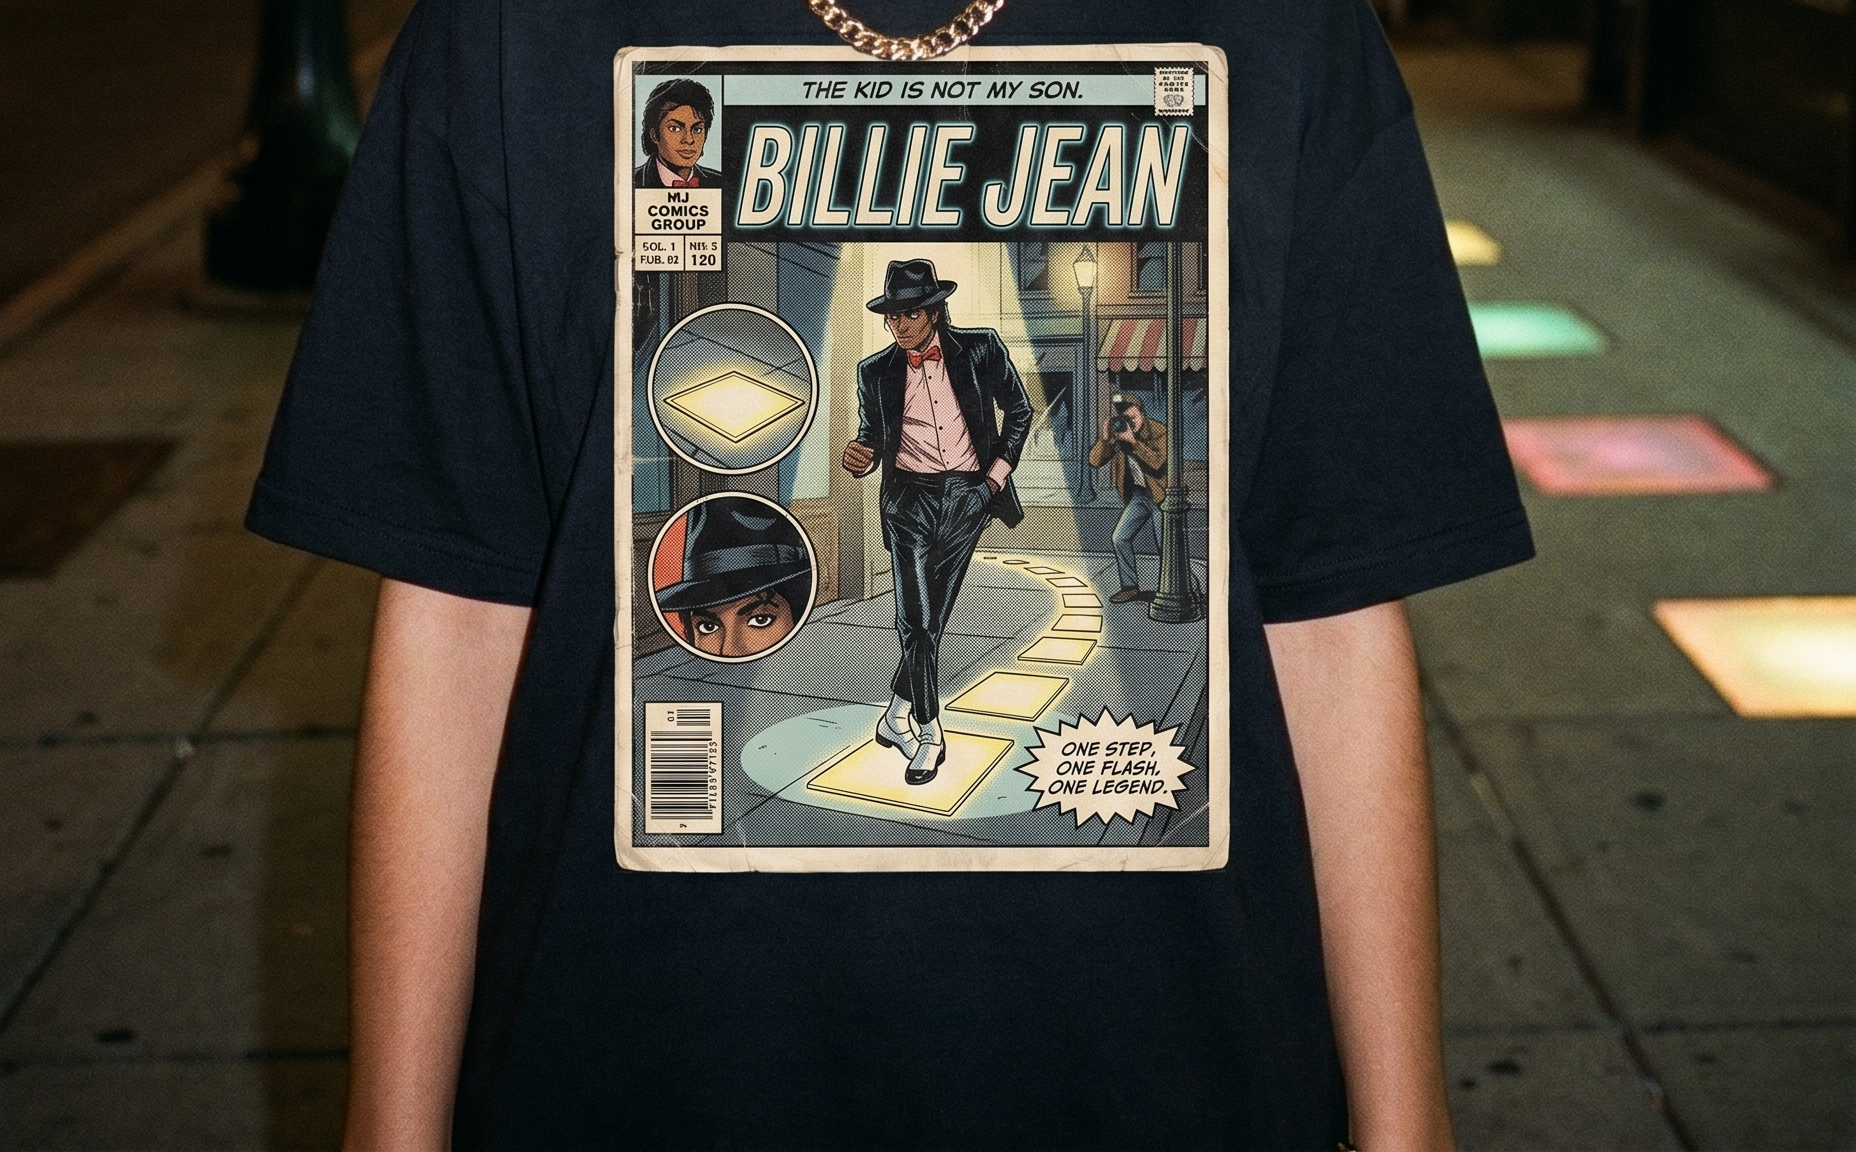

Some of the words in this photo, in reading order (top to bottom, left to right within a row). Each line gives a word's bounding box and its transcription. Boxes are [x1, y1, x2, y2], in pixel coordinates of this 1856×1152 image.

[803, 81, 847, 98] THE
[854, 81, 892, 98] KID
[901, 82, 924, 98] IS
[931, 81, 981, 98] NOT
[987, 81, 1023, 98] MY
[1029, 81, 1082, 98] SON.
[735, 124, 975, 227] BILLIE
[982, 124, 1190, 227] JEAN
[668, 192, 689, 203] MJ
[648, 206, 709, 216] COMICS
[652, 219, 706, 230] GROUP
[671, 242, 675, 252] 1
[692, 254, 716, 265] 120
[1062, 742, 1100, 756] ONE
[1106, 742, 1155, 757] STEP,
[1057, 761, 1095, 775] ONE
[1101, 761, 1160, 775] FLASH,
[1049, 780, 1087, 794] ONE
[1092, 780, 1167, 794] LEGEND.
